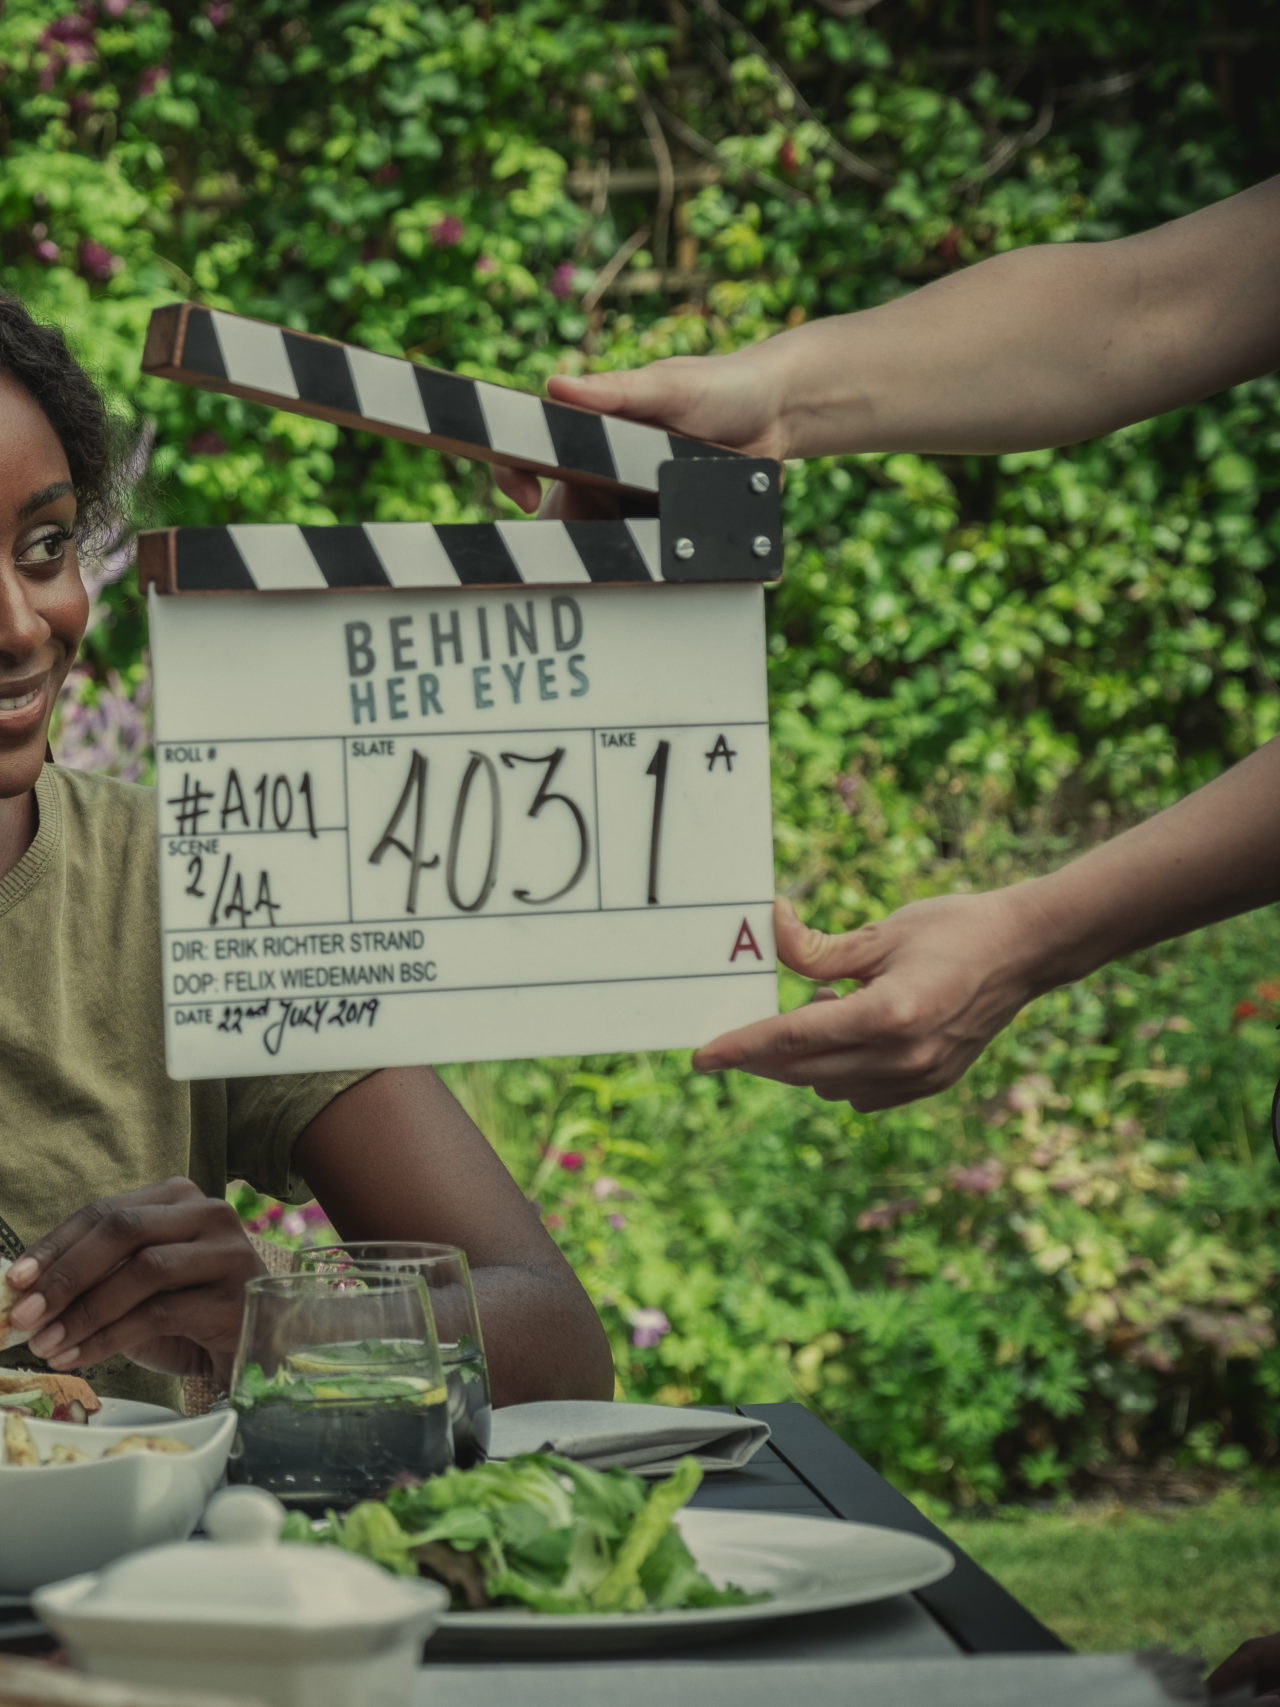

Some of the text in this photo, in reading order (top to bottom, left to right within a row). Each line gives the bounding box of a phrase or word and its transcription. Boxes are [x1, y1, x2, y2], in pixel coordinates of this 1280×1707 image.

[344, 595, 584, 677] BEHIND
[349, 653, 590, 725] HER EYES
[165, 747, 217, 763] ROLL #
[352, 740, 395, 757] SLATE
[600, 732, 637, 748] TAKE
[705, 733, 738, 773] A
[167, 768, 319, 839] #A101
[368, 748, 591, 914] 403
[646, 740, 671, 905] 1
[168, 839, 220, 856] SCENE
[172, 930, 425, 962] DIR: ERIK RICHTER STRAND
[729, 917, 763, 962] A
[173, 961, 437, 995] DOP: FELIX WIEDEMANN BSC
[175, 1008, 213, 1026] DATE
[217, 998, 270, 1034] 22nd
[328, 998, 381, 1028] 2019
